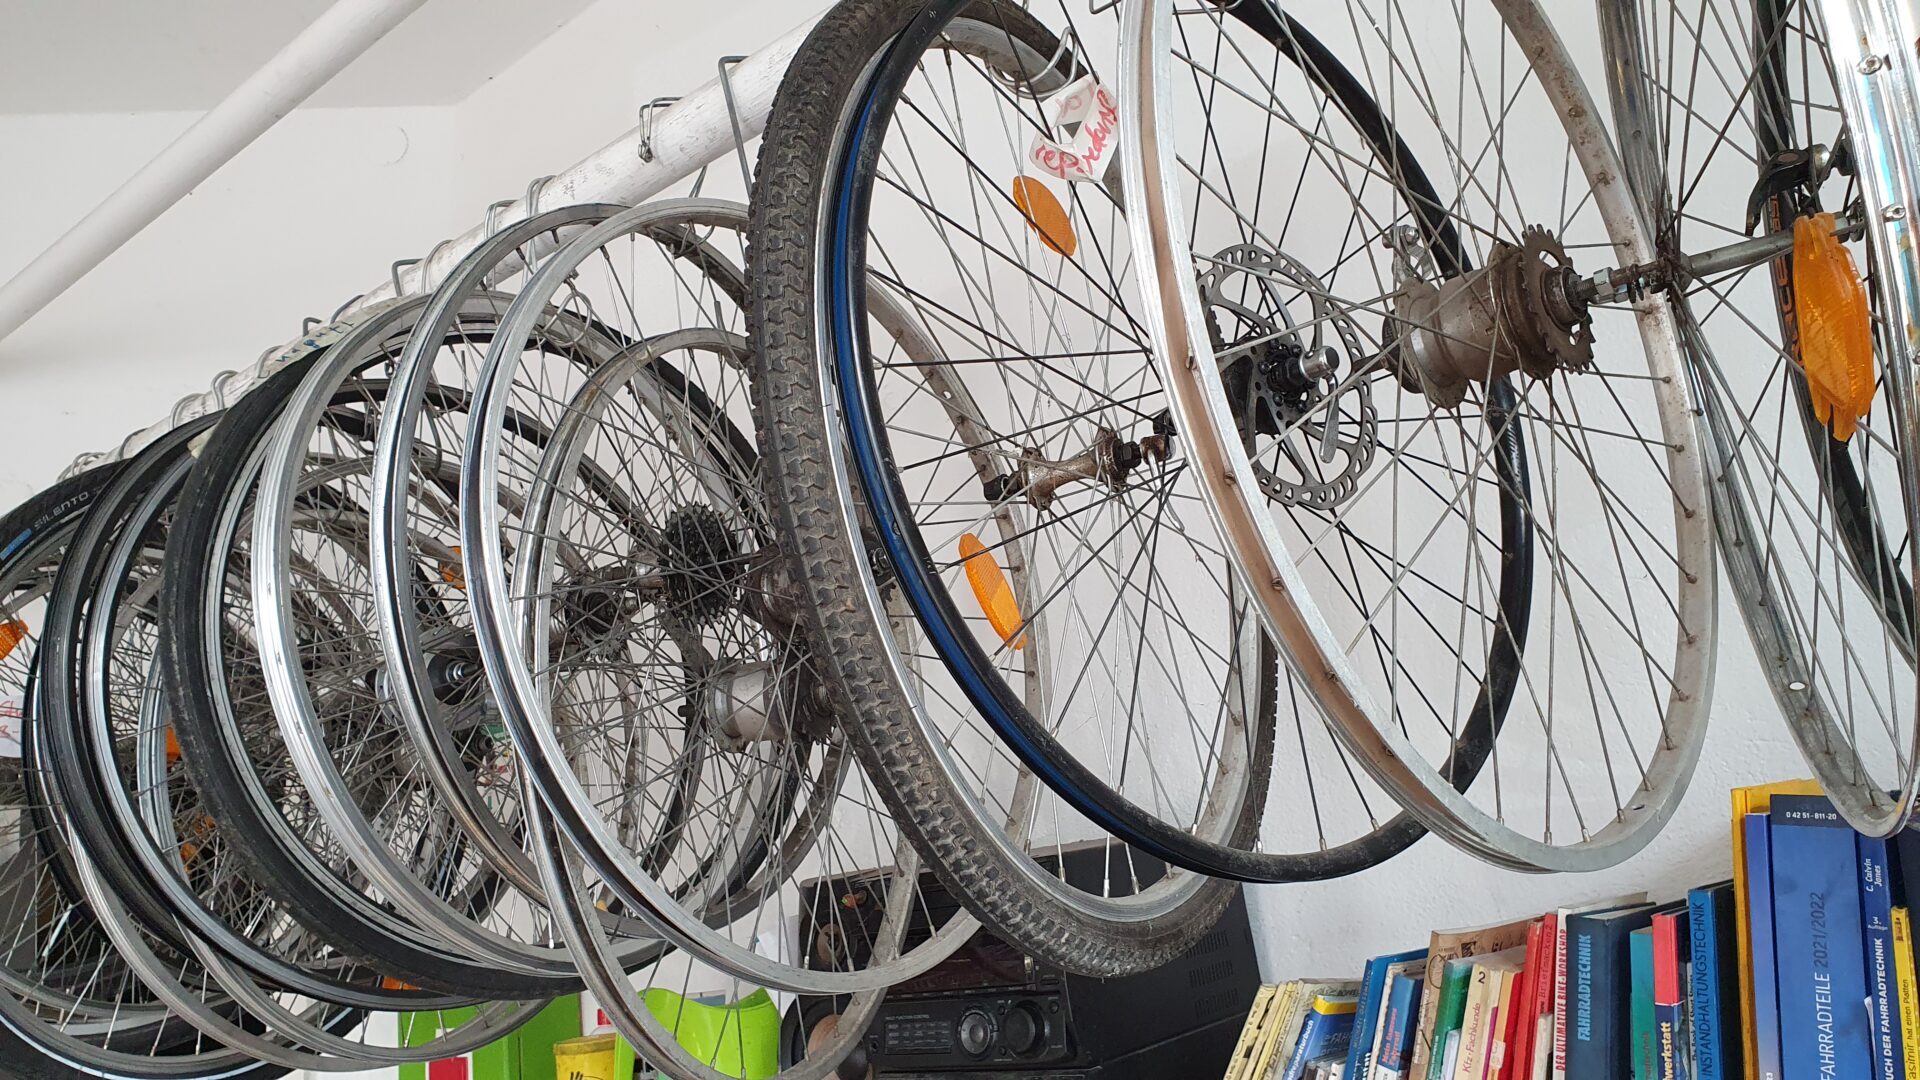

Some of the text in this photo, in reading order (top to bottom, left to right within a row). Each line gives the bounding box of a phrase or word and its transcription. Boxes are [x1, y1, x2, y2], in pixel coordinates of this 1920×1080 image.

[34, 491, 89, 530] SILENTO
[1792, 811, 1801, 819] 42
[1865, 858, 1873, 882] Calvin
[1874, 865, 1882, 886] Jones
[1478, 971, 1486, 984] 2
[1577, 934, 1591, 1041] FAHRRADTECHNIK
[1692, 902, 1713, 1077] INSTANDHALTUNGSTECHNIK
[1810, 892, 1836, 1080] FAHRRADTEILE 2021/2022
[1874, 938, 1893, 1032] FAHRRADTECHNIK
[1462, 1002, 1481, 1073] Kfz-Fachkunde
[1556, 1007, 1567, 1054] ULTIMATIVE
[1881, 1036, 1893, 1057] DER
[1902, 979, 1917, 1080] asimir hat einen Platten
[1555, 1055, 1567, 1072] DER
